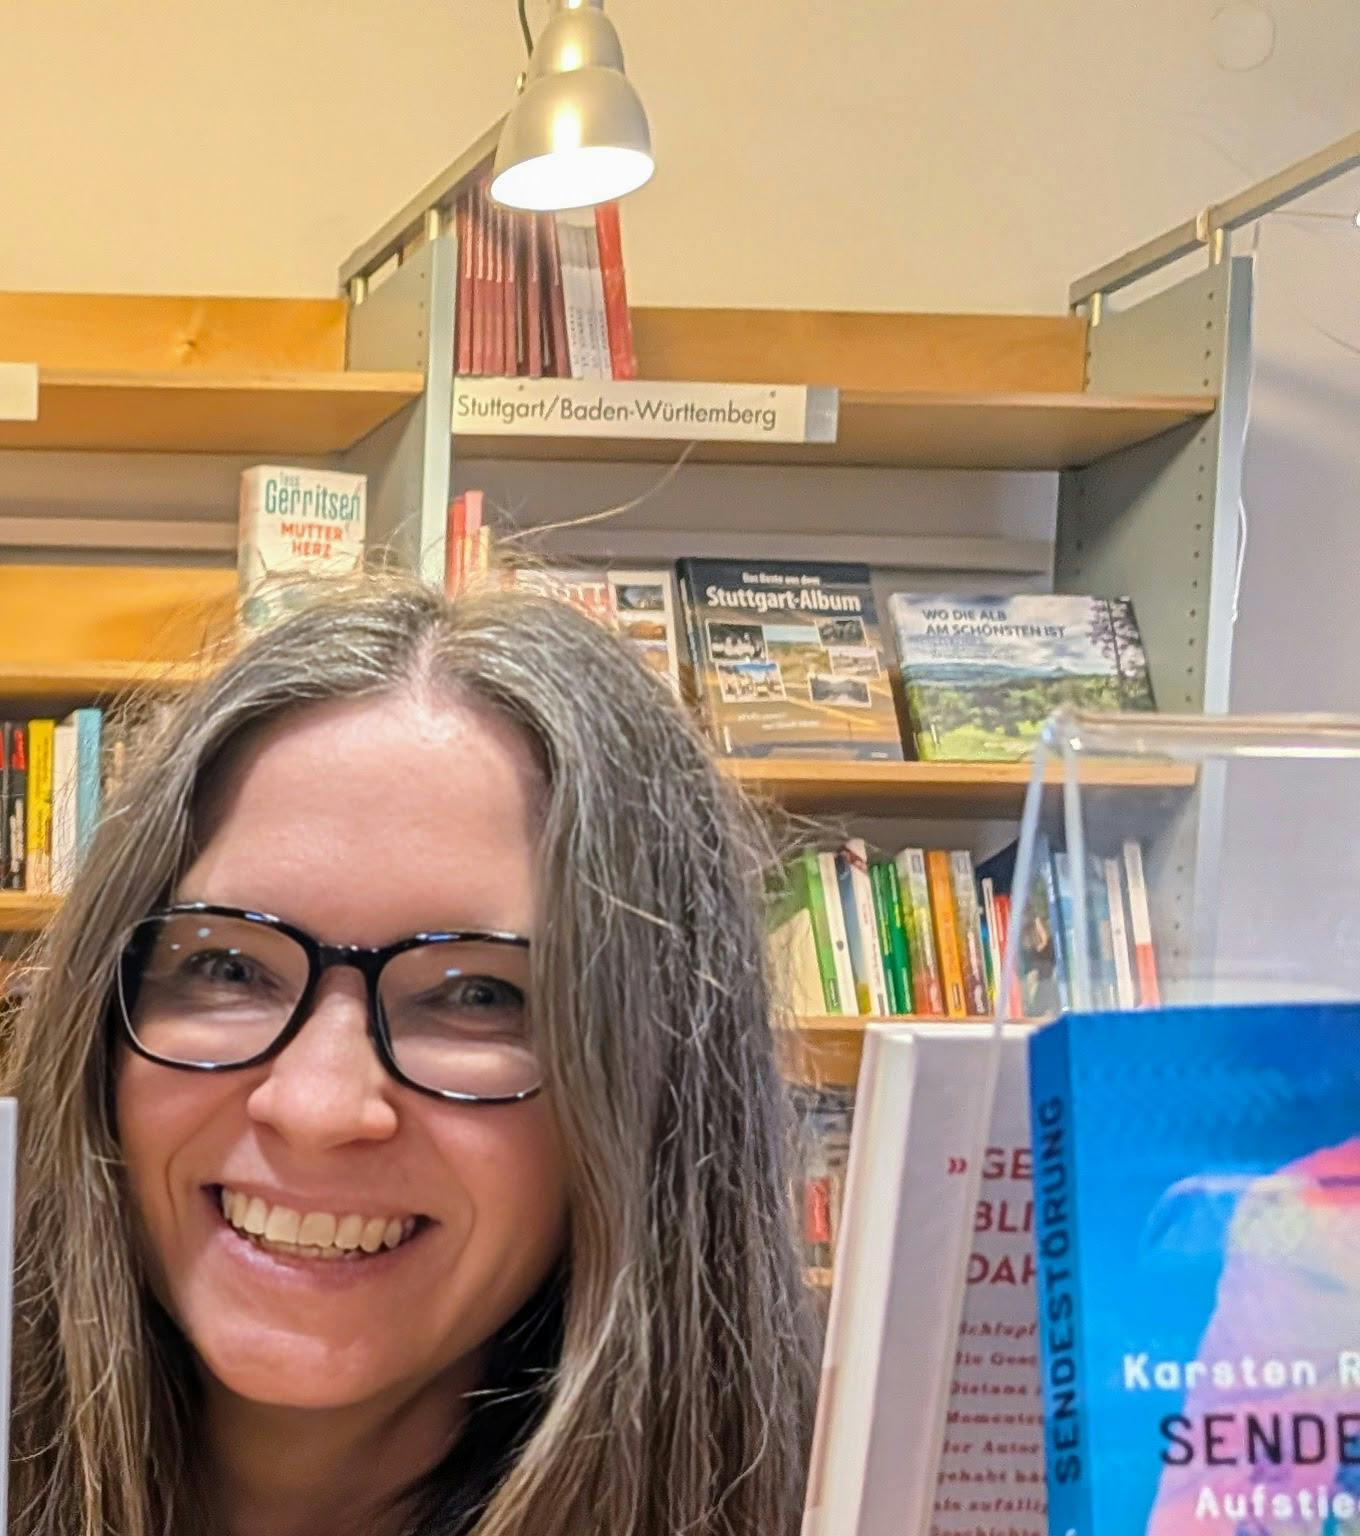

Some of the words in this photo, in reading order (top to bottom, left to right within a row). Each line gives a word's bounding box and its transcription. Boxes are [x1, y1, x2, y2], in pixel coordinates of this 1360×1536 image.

[457, 392, 777, 431] Stuttgart/Baden-Württemberg
[265, 479, 361, 521] Gerritsen
[281, 522, 343, 541] MUTTER
[706, 585, 862, 612] Stuttgart-Album
[1037, 1096, 1082, 1485] SENDESTÖRUNG
[1122, 1352, 1317, 1391] Karsten
[1195, 1484, 1360, 1522] Aufstie
